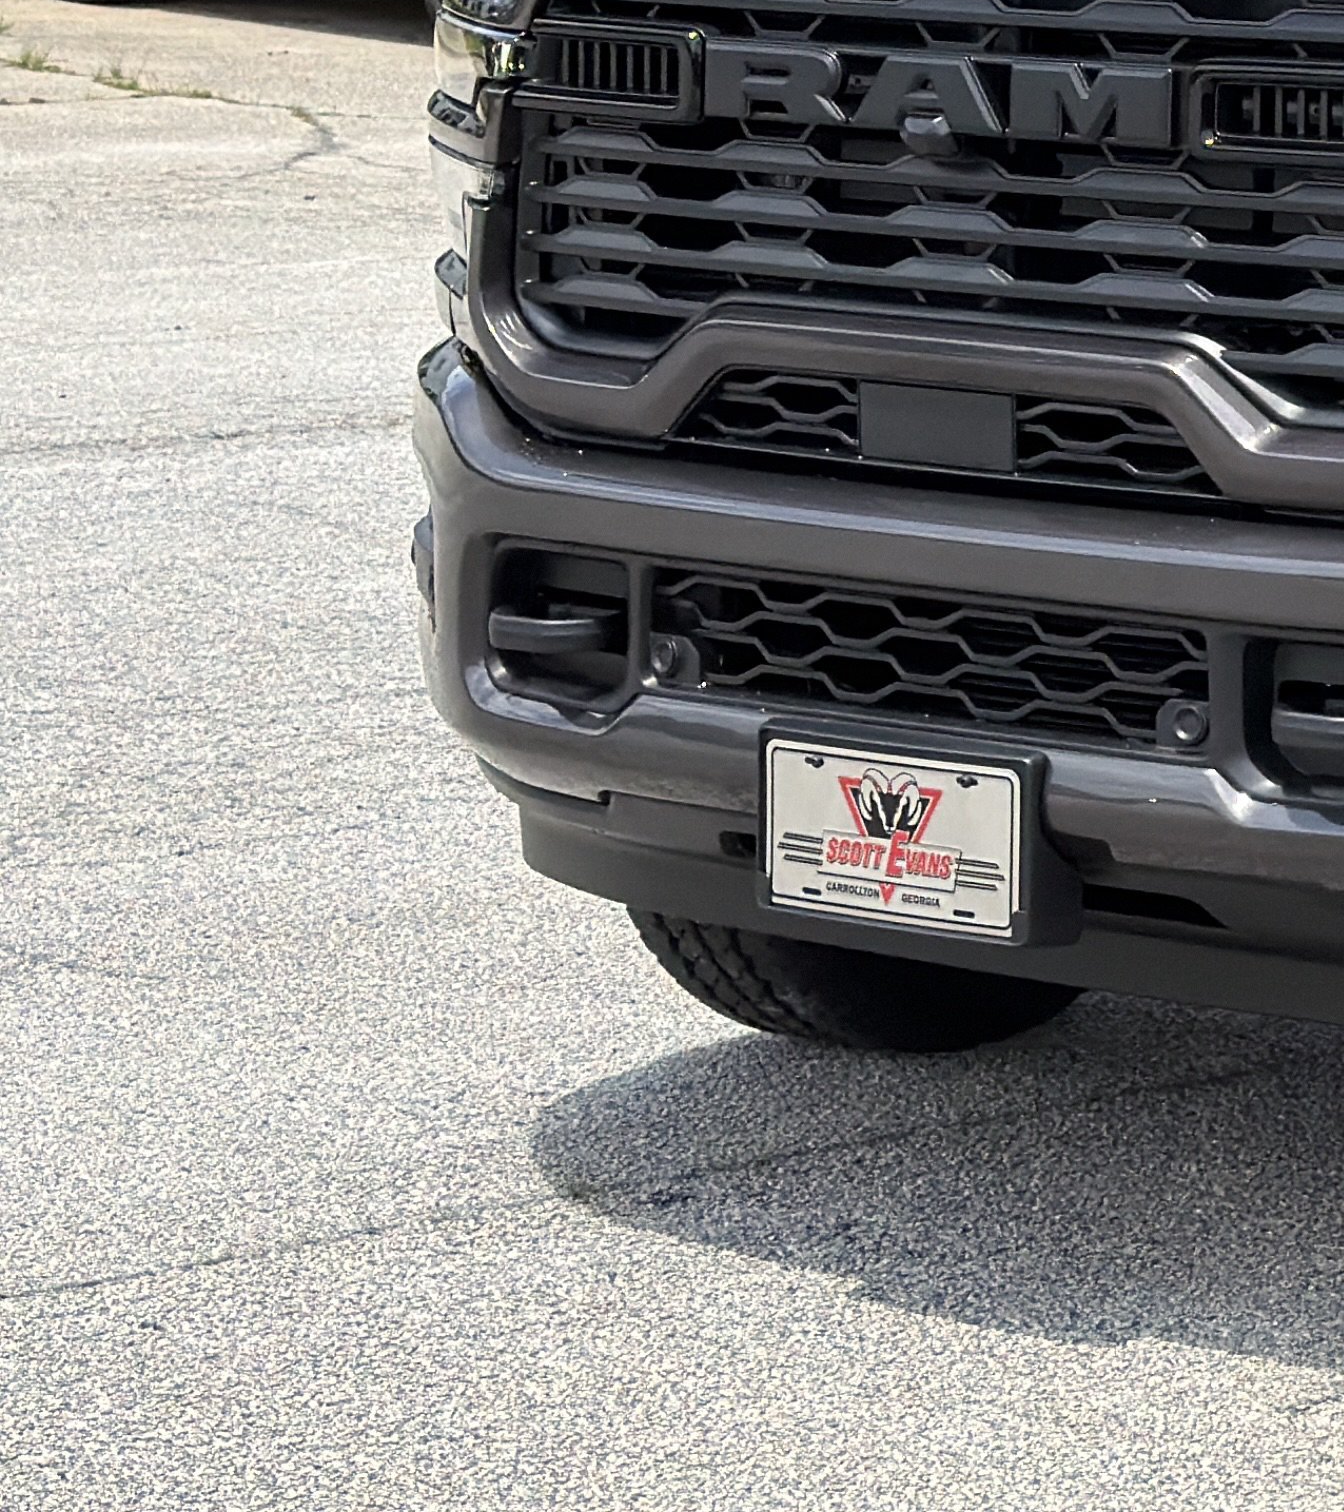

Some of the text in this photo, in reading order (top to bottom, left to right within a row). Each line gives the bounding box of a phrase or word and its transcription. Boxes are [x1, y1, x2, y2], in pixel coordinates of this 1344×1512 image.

[703, 40, 1175, 148] RAM
[826, 829, 954, 880] SCOTT EVANS
[825, 881, 941, 908] CARROLLTON GEORGIA
